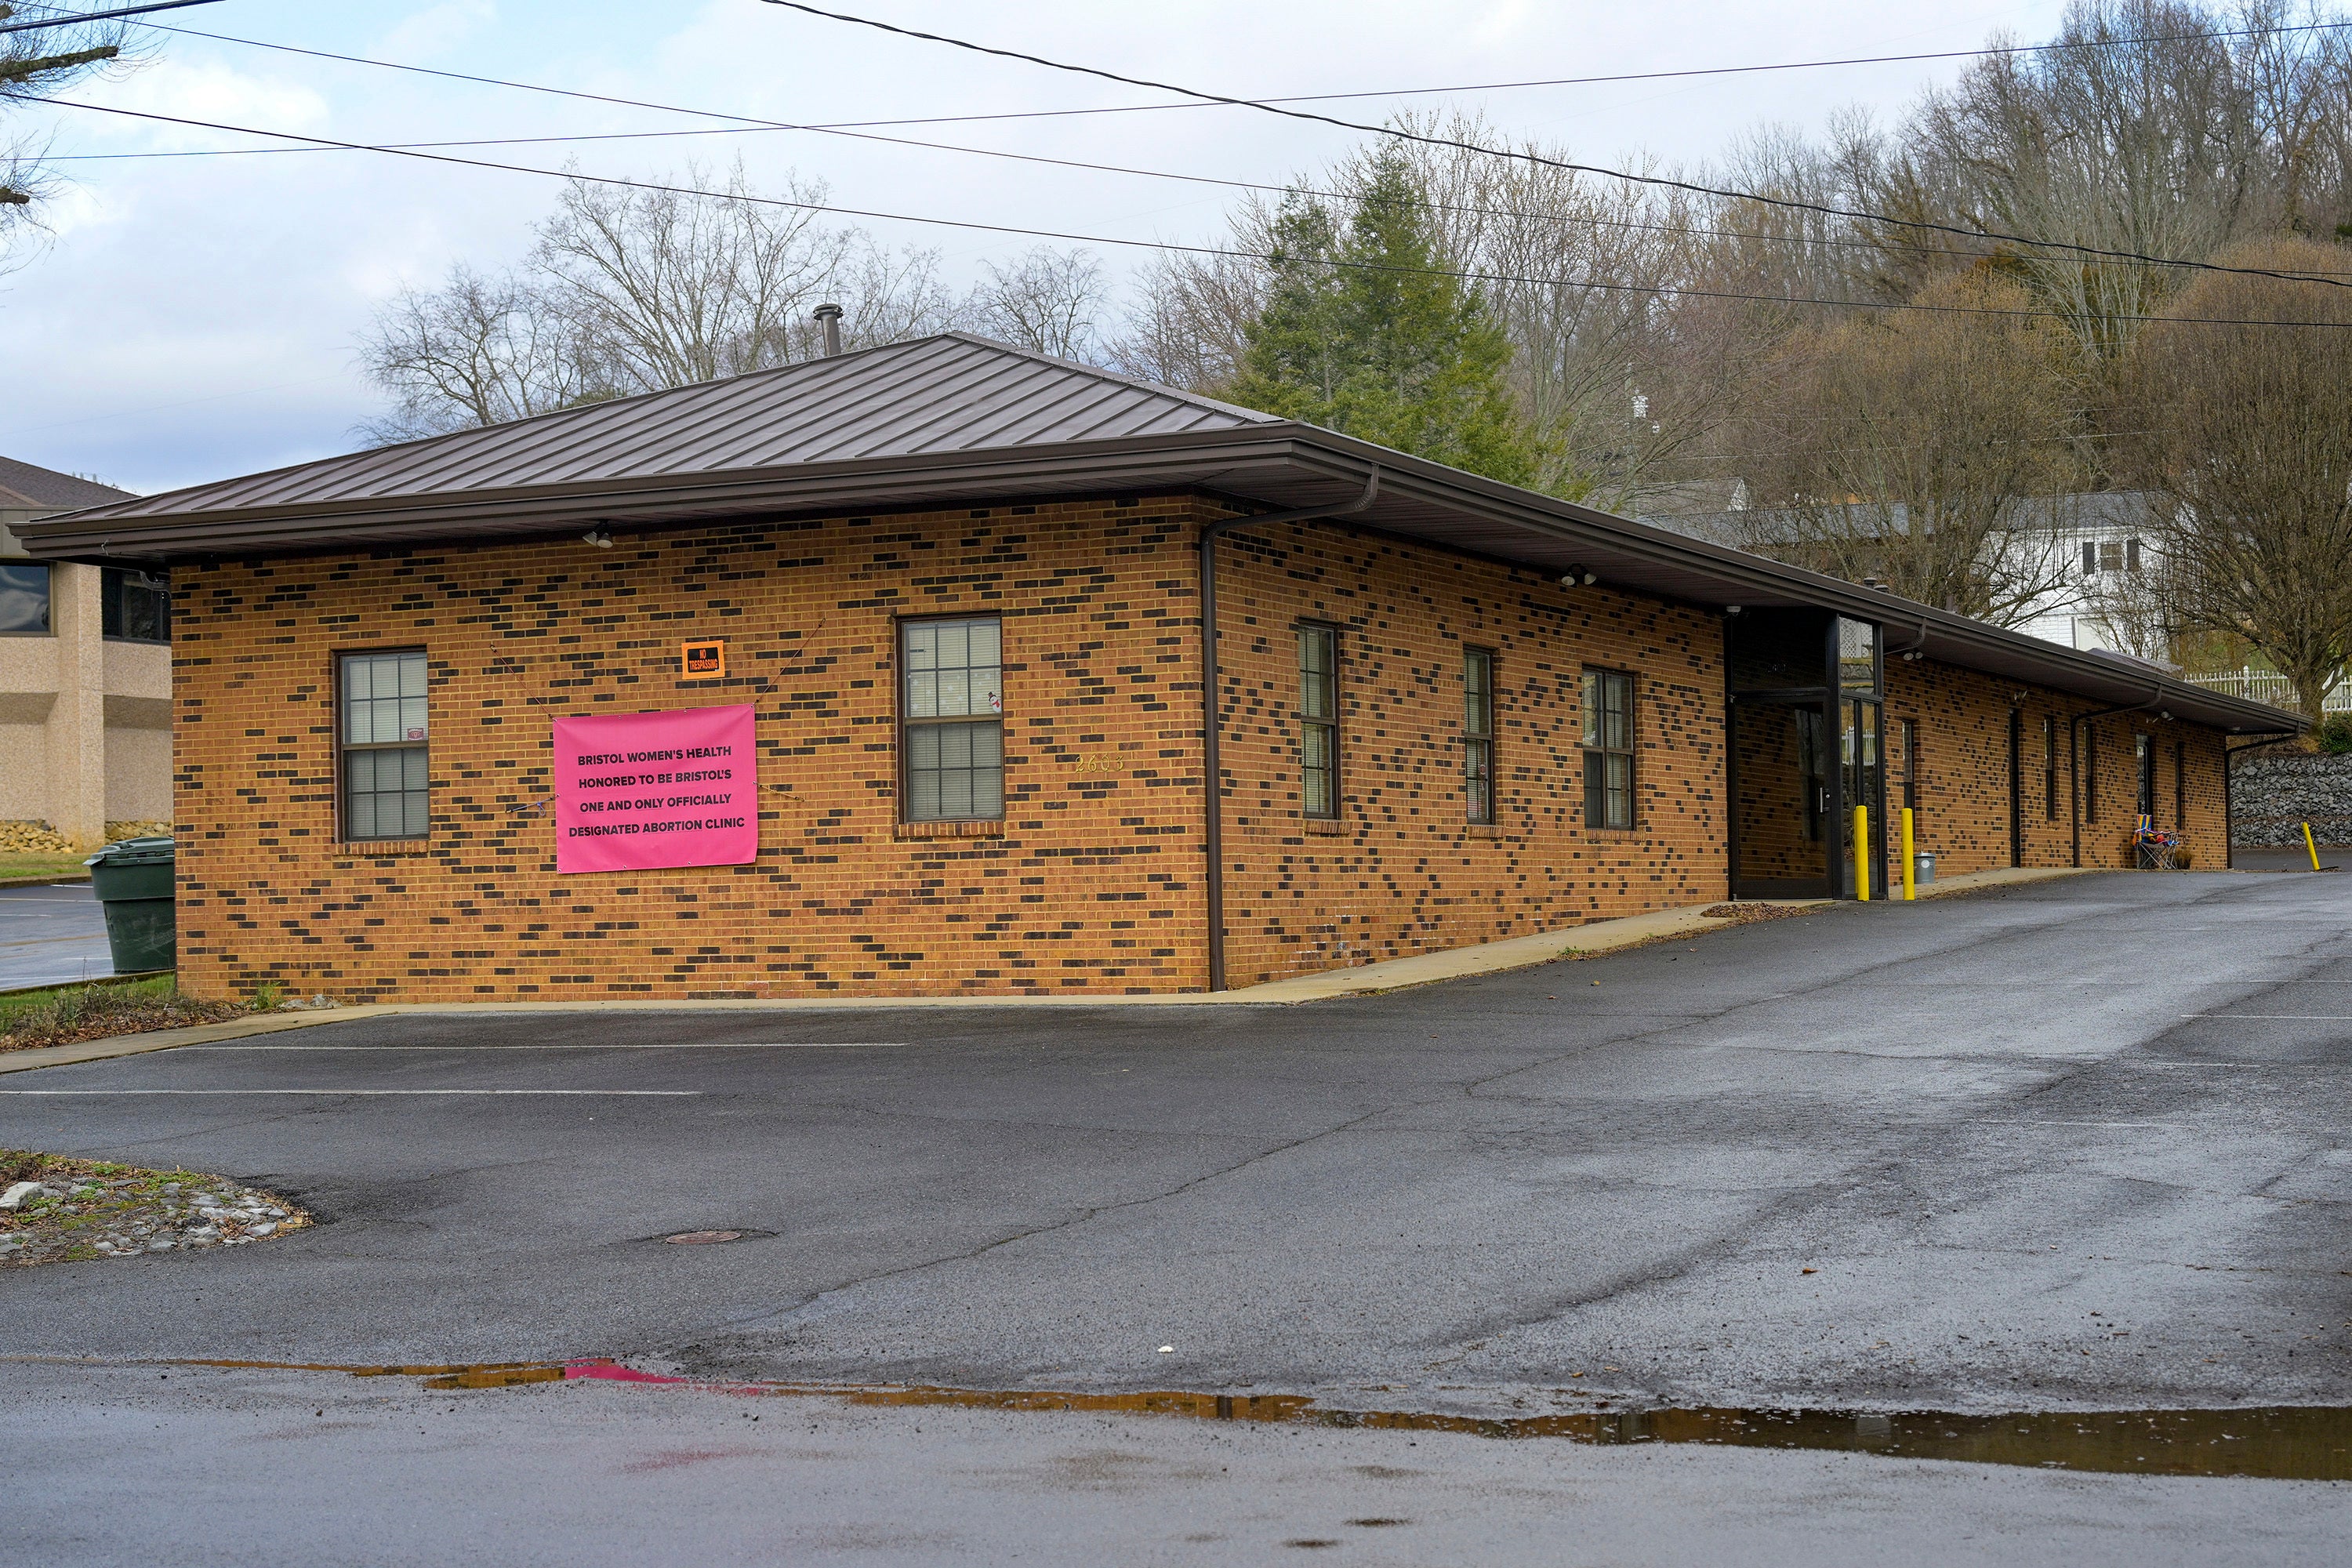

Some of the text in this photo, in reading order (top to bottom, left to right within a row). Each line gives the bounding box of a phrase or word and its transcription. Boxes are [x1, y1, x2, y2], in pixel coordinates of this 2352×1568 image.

[699, 649, 706, 659] NO
[689, 659, 717, 670] TRESPASSING
[578, 746, 731, 766] BRISTOL WOMEN'S HEALTH
[1076, 754, 1123, 772] 2603
[579, 769, 731, 789] HONORED TO BE BRISTOL'S
[579, 793, 731, 813] ONE AND ONLY OFFICIALLY
[569, 818, 745, 837] DESIGNATED ABORTION CLINIC
